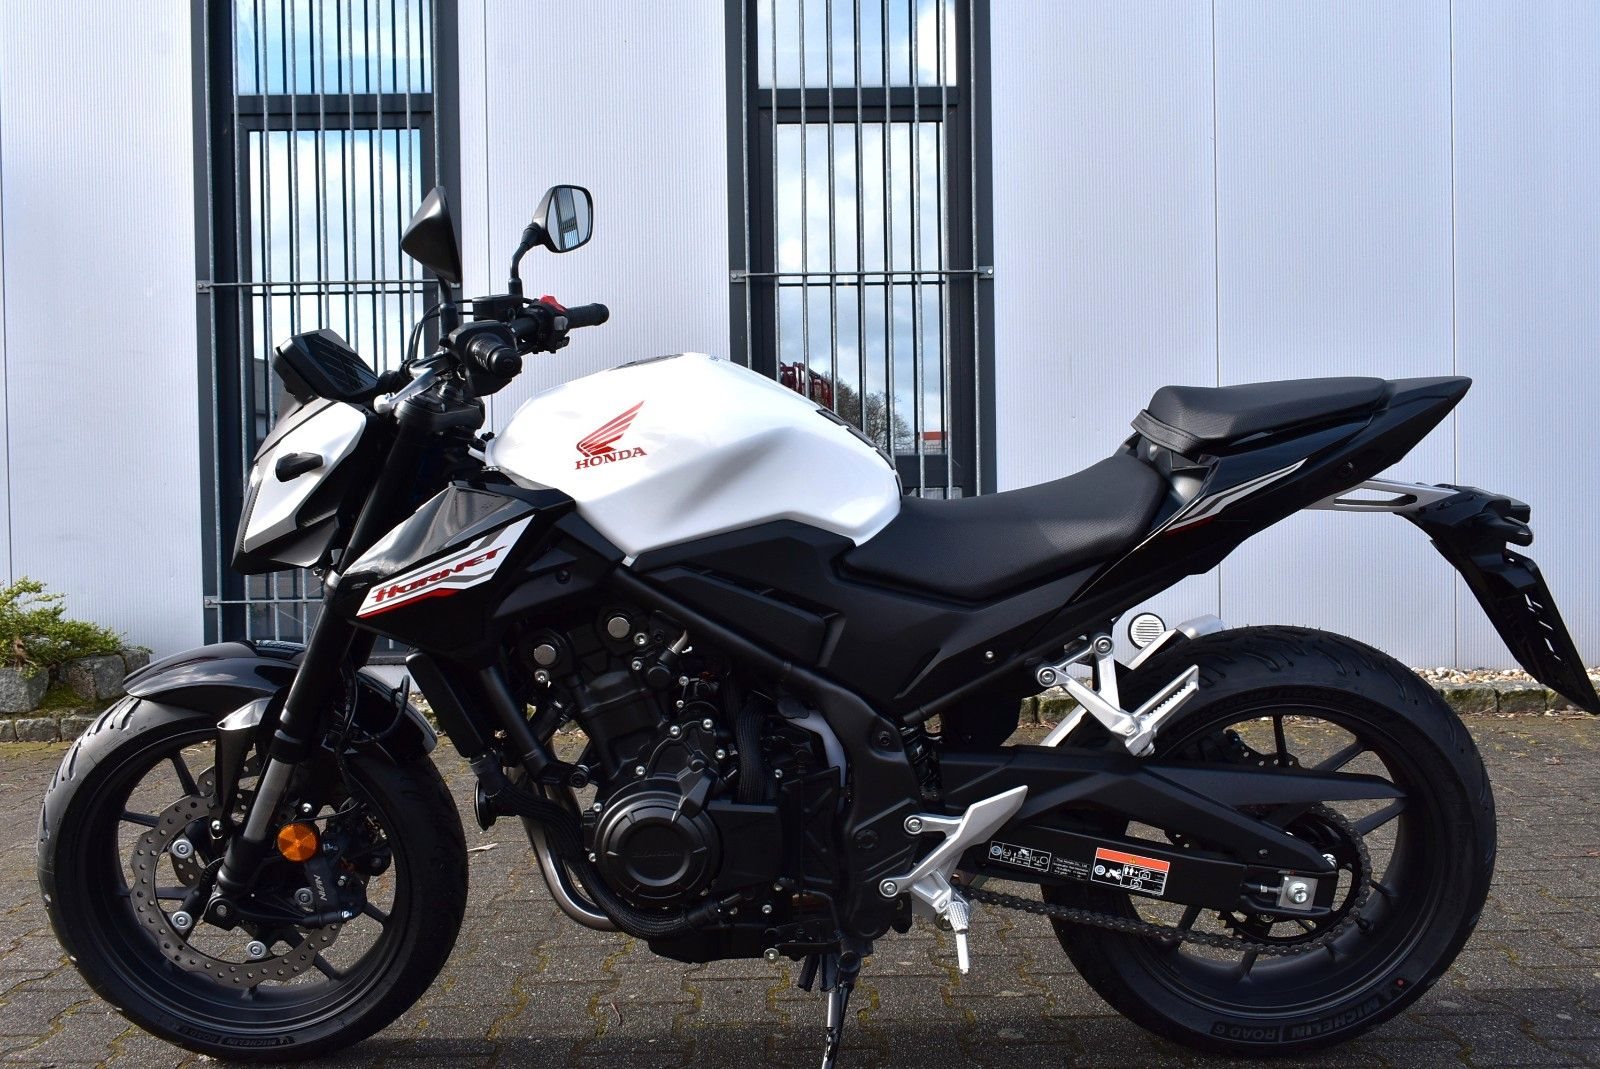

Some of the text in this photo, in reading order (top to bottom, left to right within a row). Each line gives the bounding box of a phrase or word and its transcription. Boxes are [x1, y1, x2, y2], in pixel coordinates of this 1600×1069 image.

[575, 446, 648, 470] HONDA
[371, 545, 508, 603] HORNET
[1229, 1025, 1276, 1041] ROAD
[1291, 998, 1381, 1039] MICHELIN
